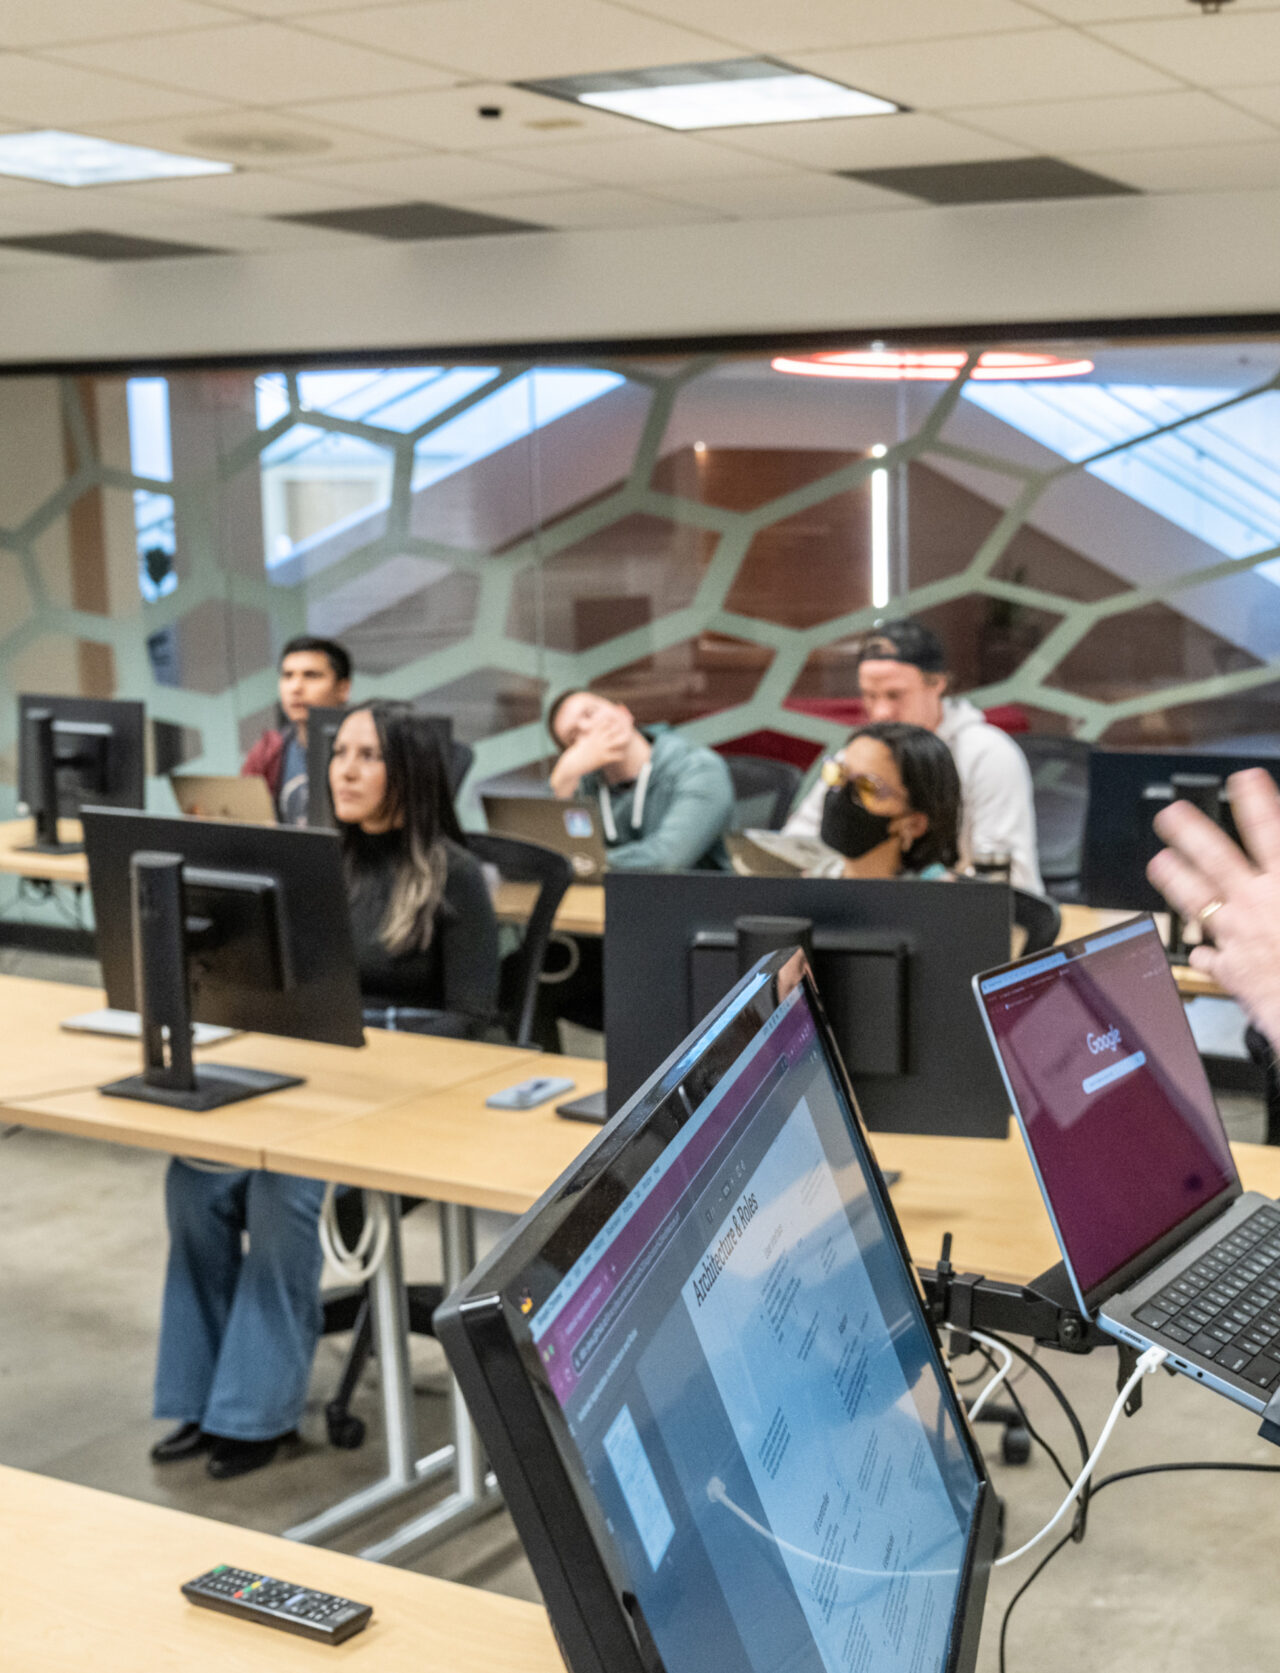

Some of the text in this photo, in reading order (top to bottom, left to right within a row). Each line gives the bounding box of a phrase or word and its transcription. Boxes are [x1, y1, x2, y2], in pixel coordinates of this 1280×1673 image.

[1086, 1023, 1122, 1055] Google
[693, 1192, 759, 1307] Architecture & Roles
